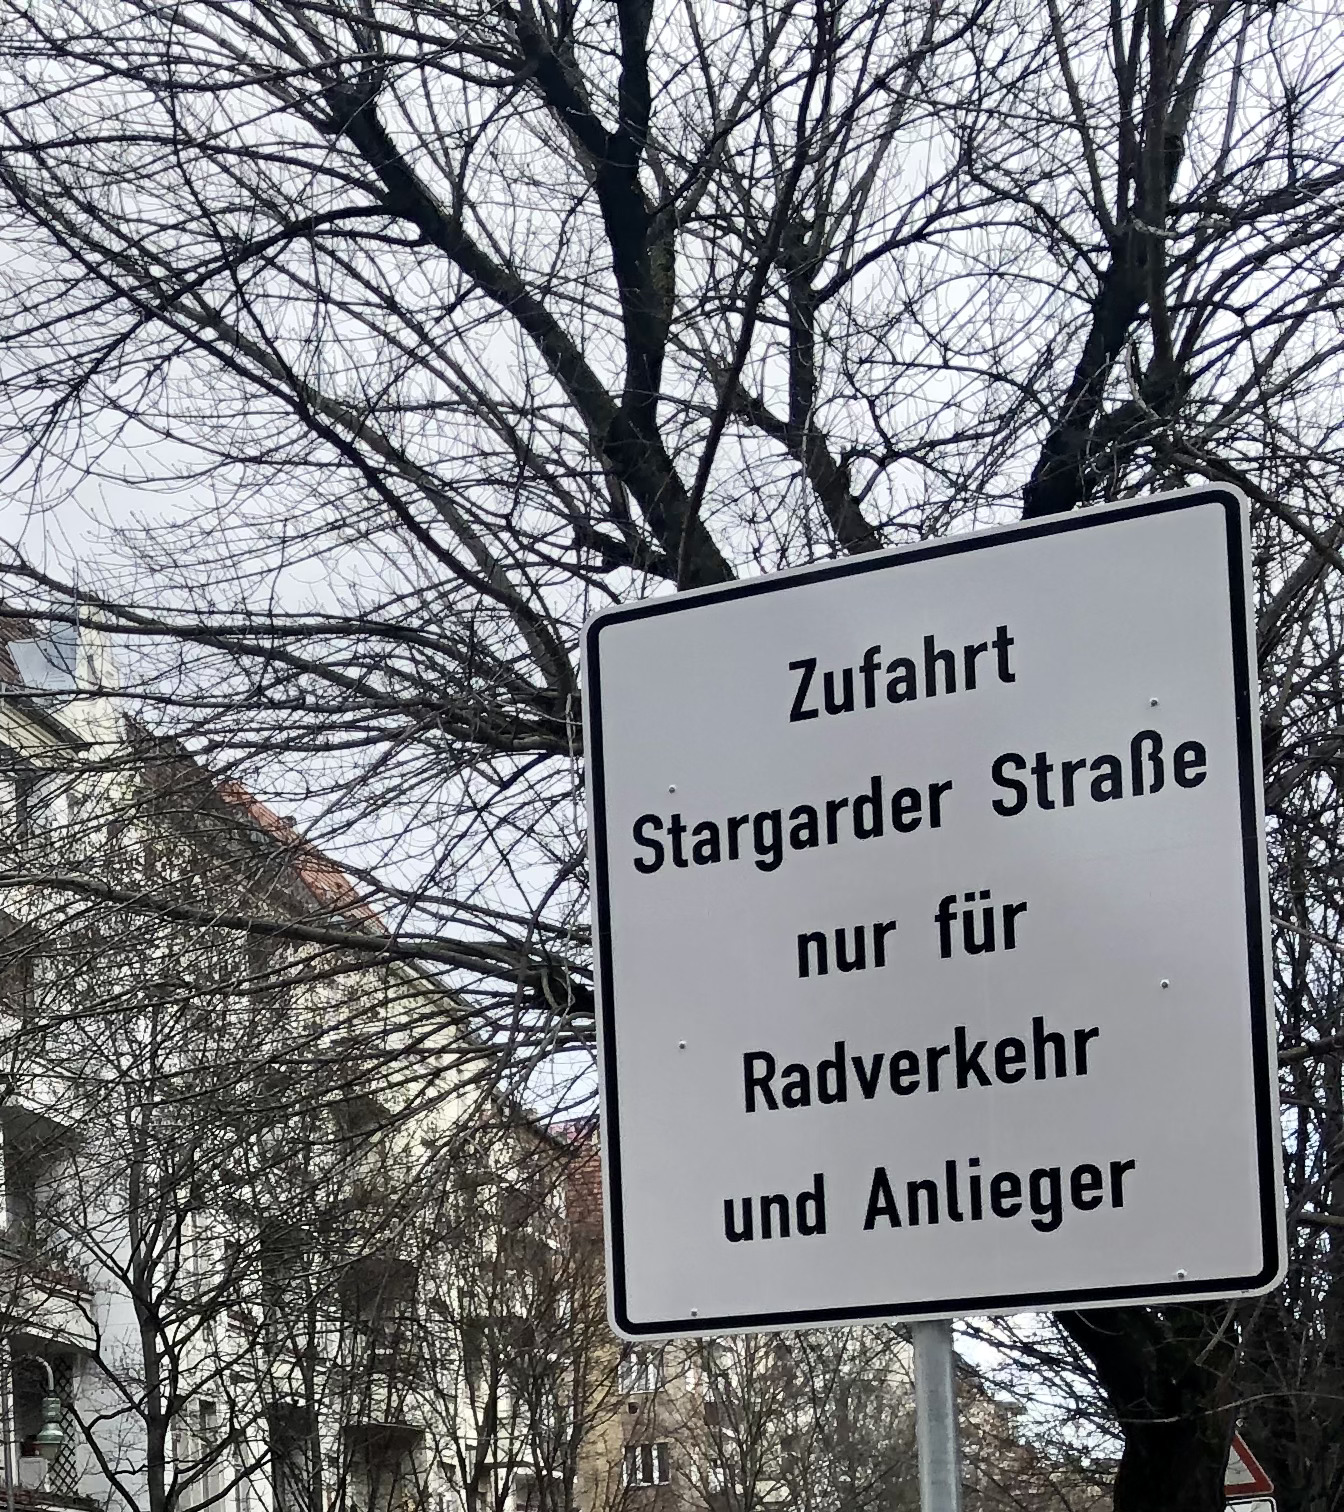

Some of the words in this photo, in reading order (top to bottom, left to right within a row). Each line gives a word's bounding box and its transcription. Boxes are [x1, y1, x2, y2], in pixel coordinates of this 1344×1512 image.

[789, 625, 1016, 722] Zufahrt
[633, 776, 953, 875] Stargarder
[991, 729, 1207, 819] Straße
[797, 918, 896, 978] nur
[935, 889, 1028, 959] für
[743, 1016, 1100, 1113] Radverkehr
[724, 1173, 827, 1243] und
[863, 1156, 1136, 1233] Anlieger
